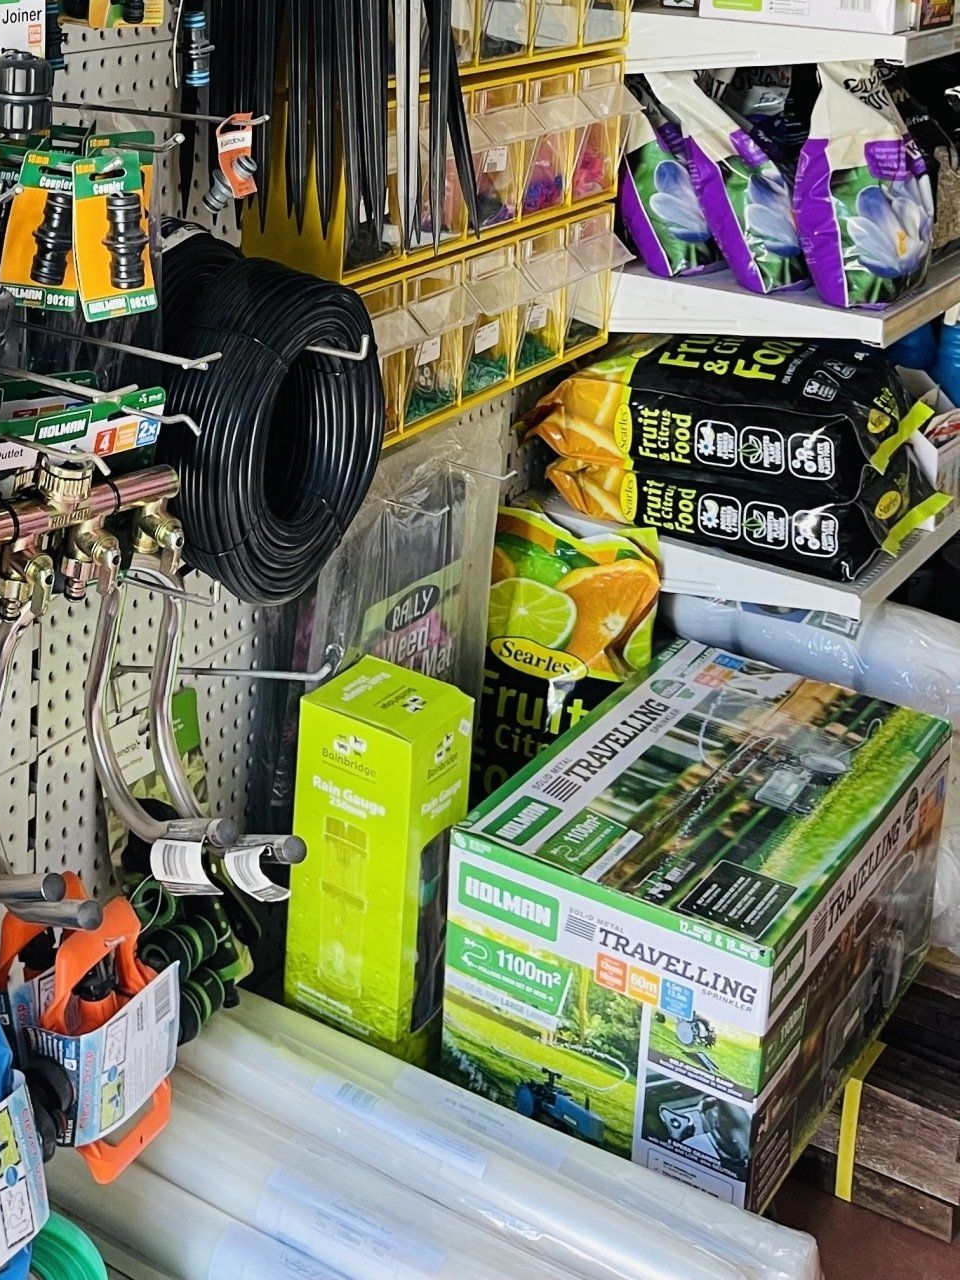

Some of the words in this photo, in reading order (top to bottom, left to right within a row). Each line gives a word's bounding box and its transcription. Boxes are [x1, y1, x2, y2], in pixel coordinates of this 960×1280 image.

[2, 8, 42, 25] Joiner
[39, 175, 73, 190] Coupler
[92, 180, 125, 194] Coupler
[38, 418, 87, 439] HOLMAN
[104, 436, 109, 451] 4
[139, 421, 156, 434] 2x
[638, 407, 660, 459] Fruit
[658, 409, 672, 449] Citrus
[671, 413, 692, 463] Food
[659, 453, 670, 461] &
[643, 480, 665, 527] Fruit
[661, 485, 677, 519] Citrus
[675, 488, 696, 534] Food
[663, 522, 674, 530] &
[383, 624, 429, 660] Weed
[498, 641, 572, 675] Searles
[649, 708, 681, 734] SPRINKLER
[563, 698, 671, 783] TRAVELLING
[322, 747, 377, 778] Bainbridge
[312, 776, 342, 795] Rain
[342, 786, 386, 816] Gauge
[495, 802, 549, 840] HOLMAN
[828, 816, 902, 930] TRAVELLING
[465, 876, 550, 928] HOLMAN
[568, 907, 594, 920] SOLID
[596, 919, 624, 933] METAL
[599, 928, 758, 1006] TRAVELLING
[701, 988, 753, 1013] SPRINKLER
